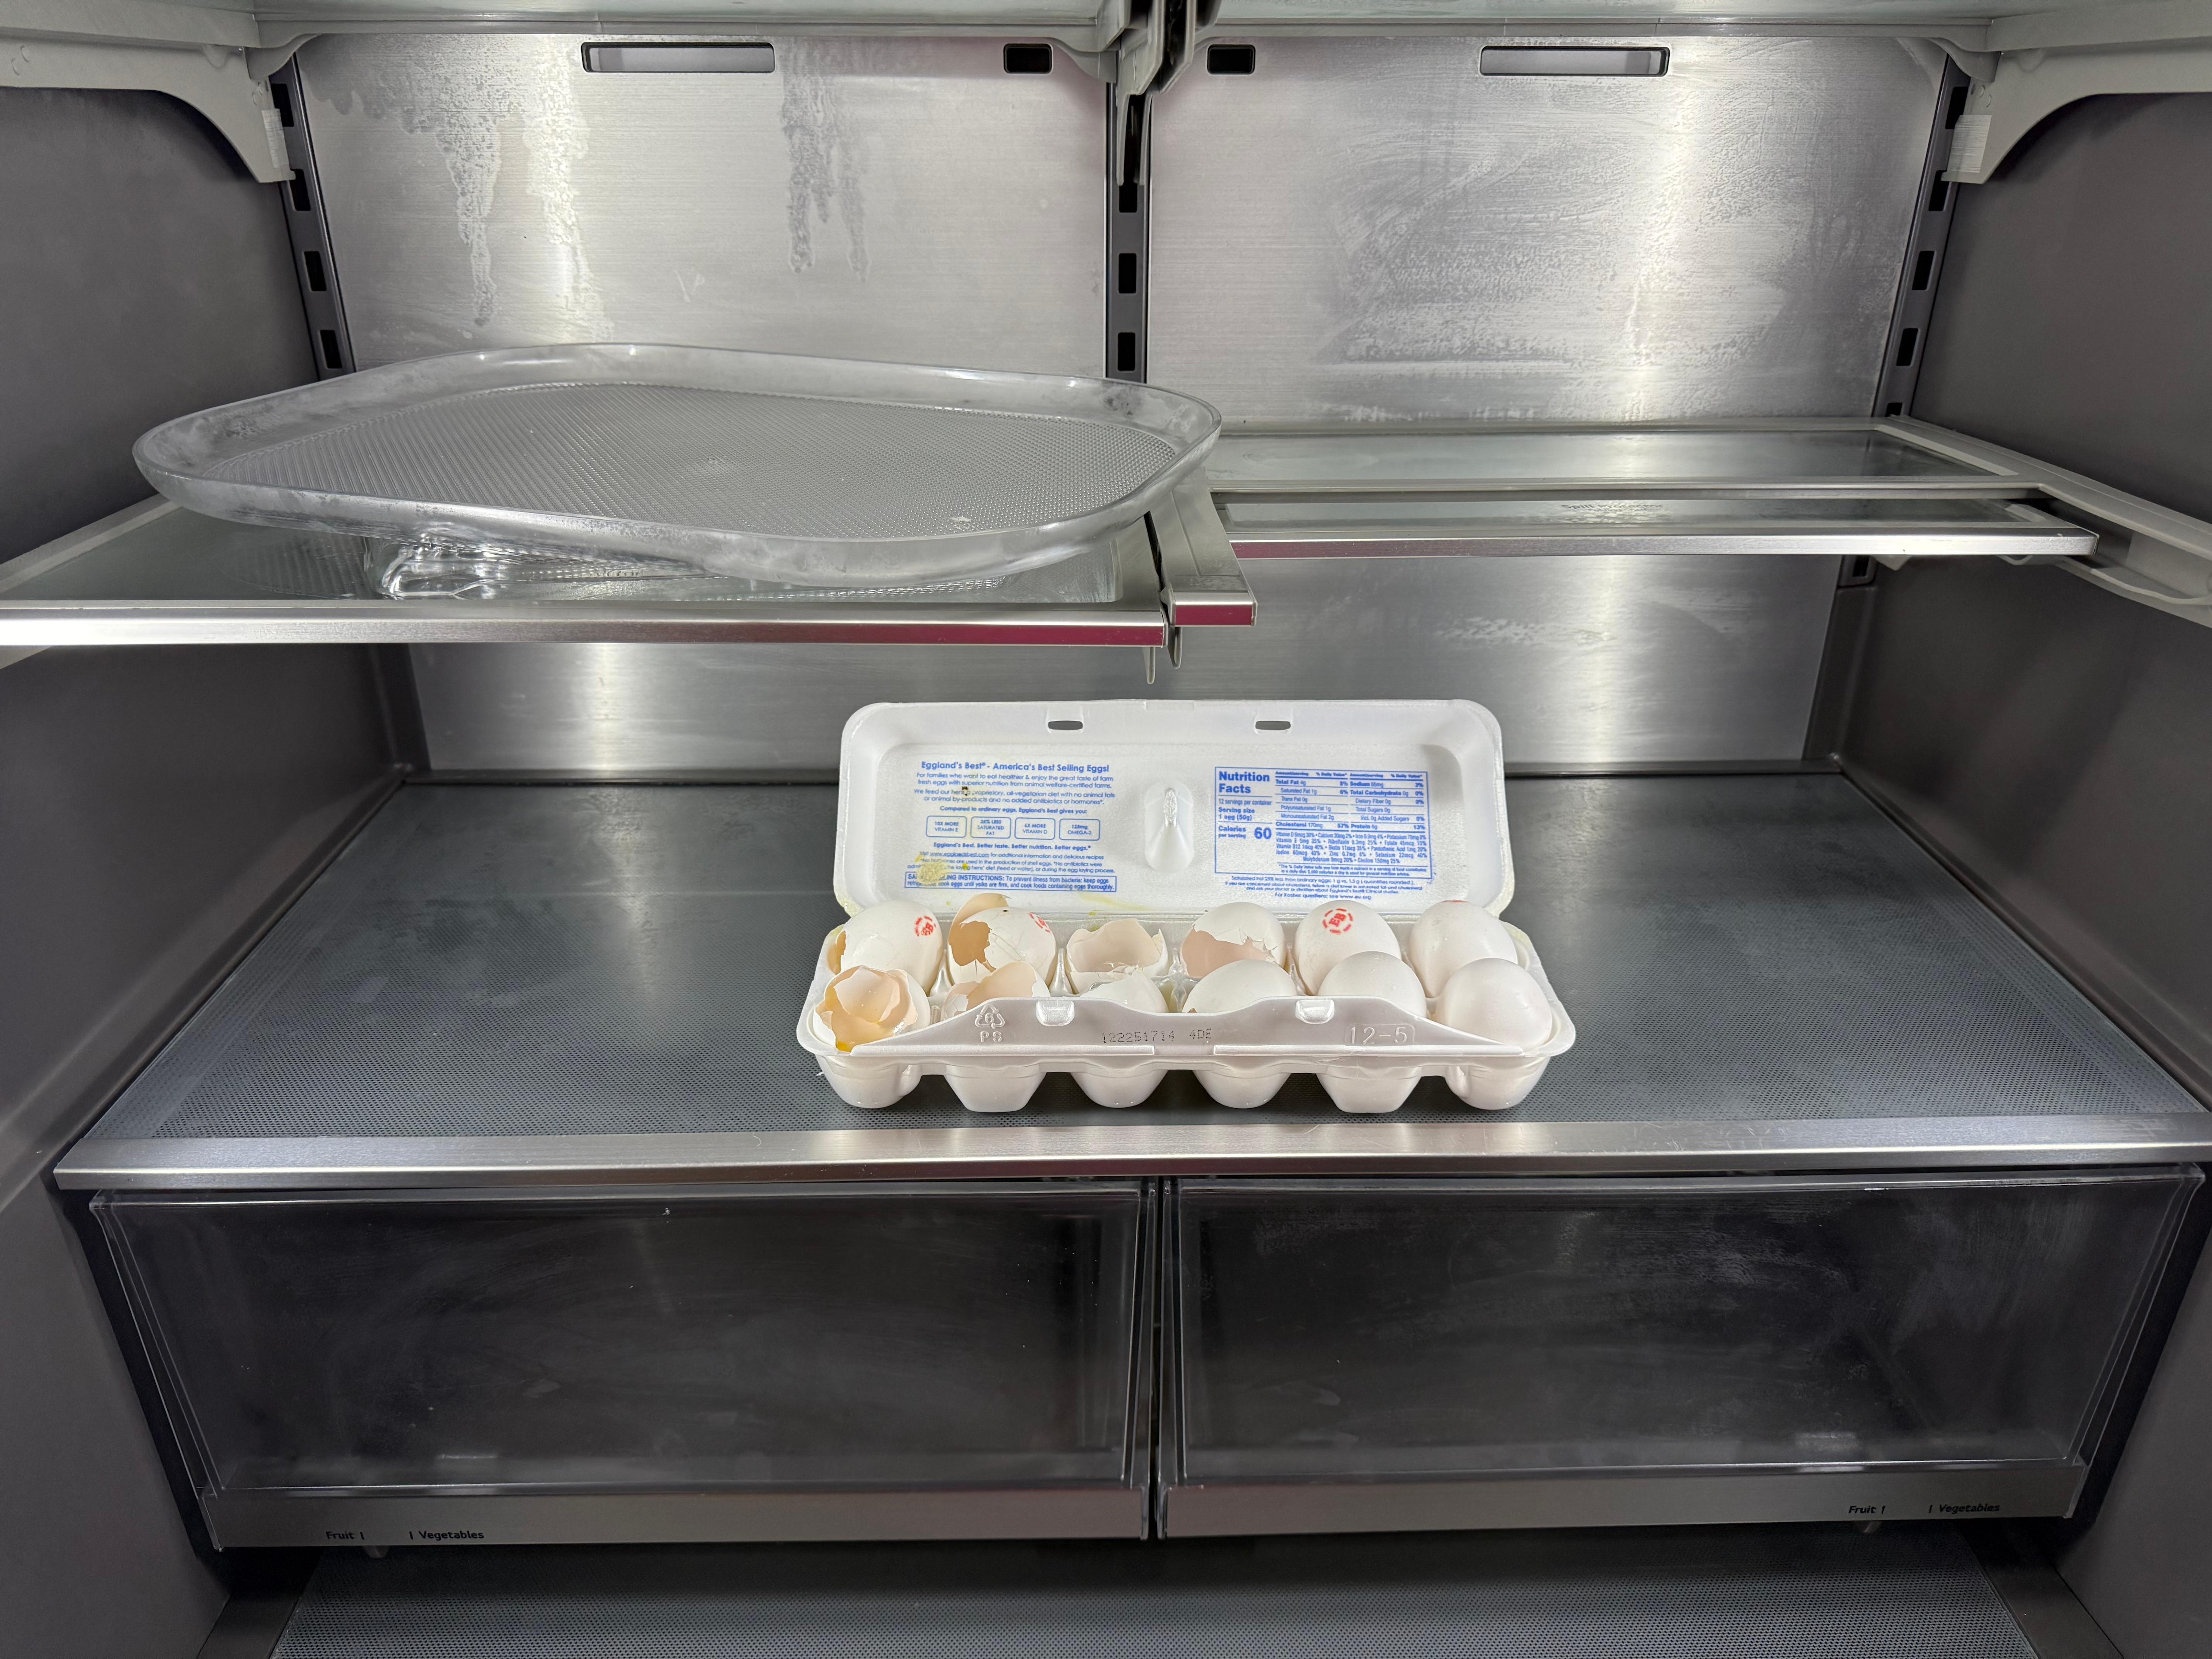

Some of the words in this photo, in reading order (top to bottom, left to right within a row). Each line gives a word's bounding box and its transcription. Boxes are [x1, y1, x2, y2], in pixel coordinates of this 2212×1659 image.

[922, 762, 962, 771] Eggland's
[1057, 764, 1084, 773] Selling
[1087, 764, 1109, 773] Eggs!
[1219, 771, 1270, 781] Nutrition
[1219, 783, 1251, 793] Facts
[1254, 827, 1271, 839] 60
[1329, 912, 1346, 927] EB
[980, 1031, 1002, 1043] PS
[1102, 1030, 1175, 1044] 122251714
[1350, 1027, 1407, 1045] 12-5
[1848, 1505, 1877, 1514] Fruit
[1939, 1503, 2000, 1514] Vegetables
[325, 1531, 355, 1540] Fruit
[419, 1530, 484, 1540] Vegetables
